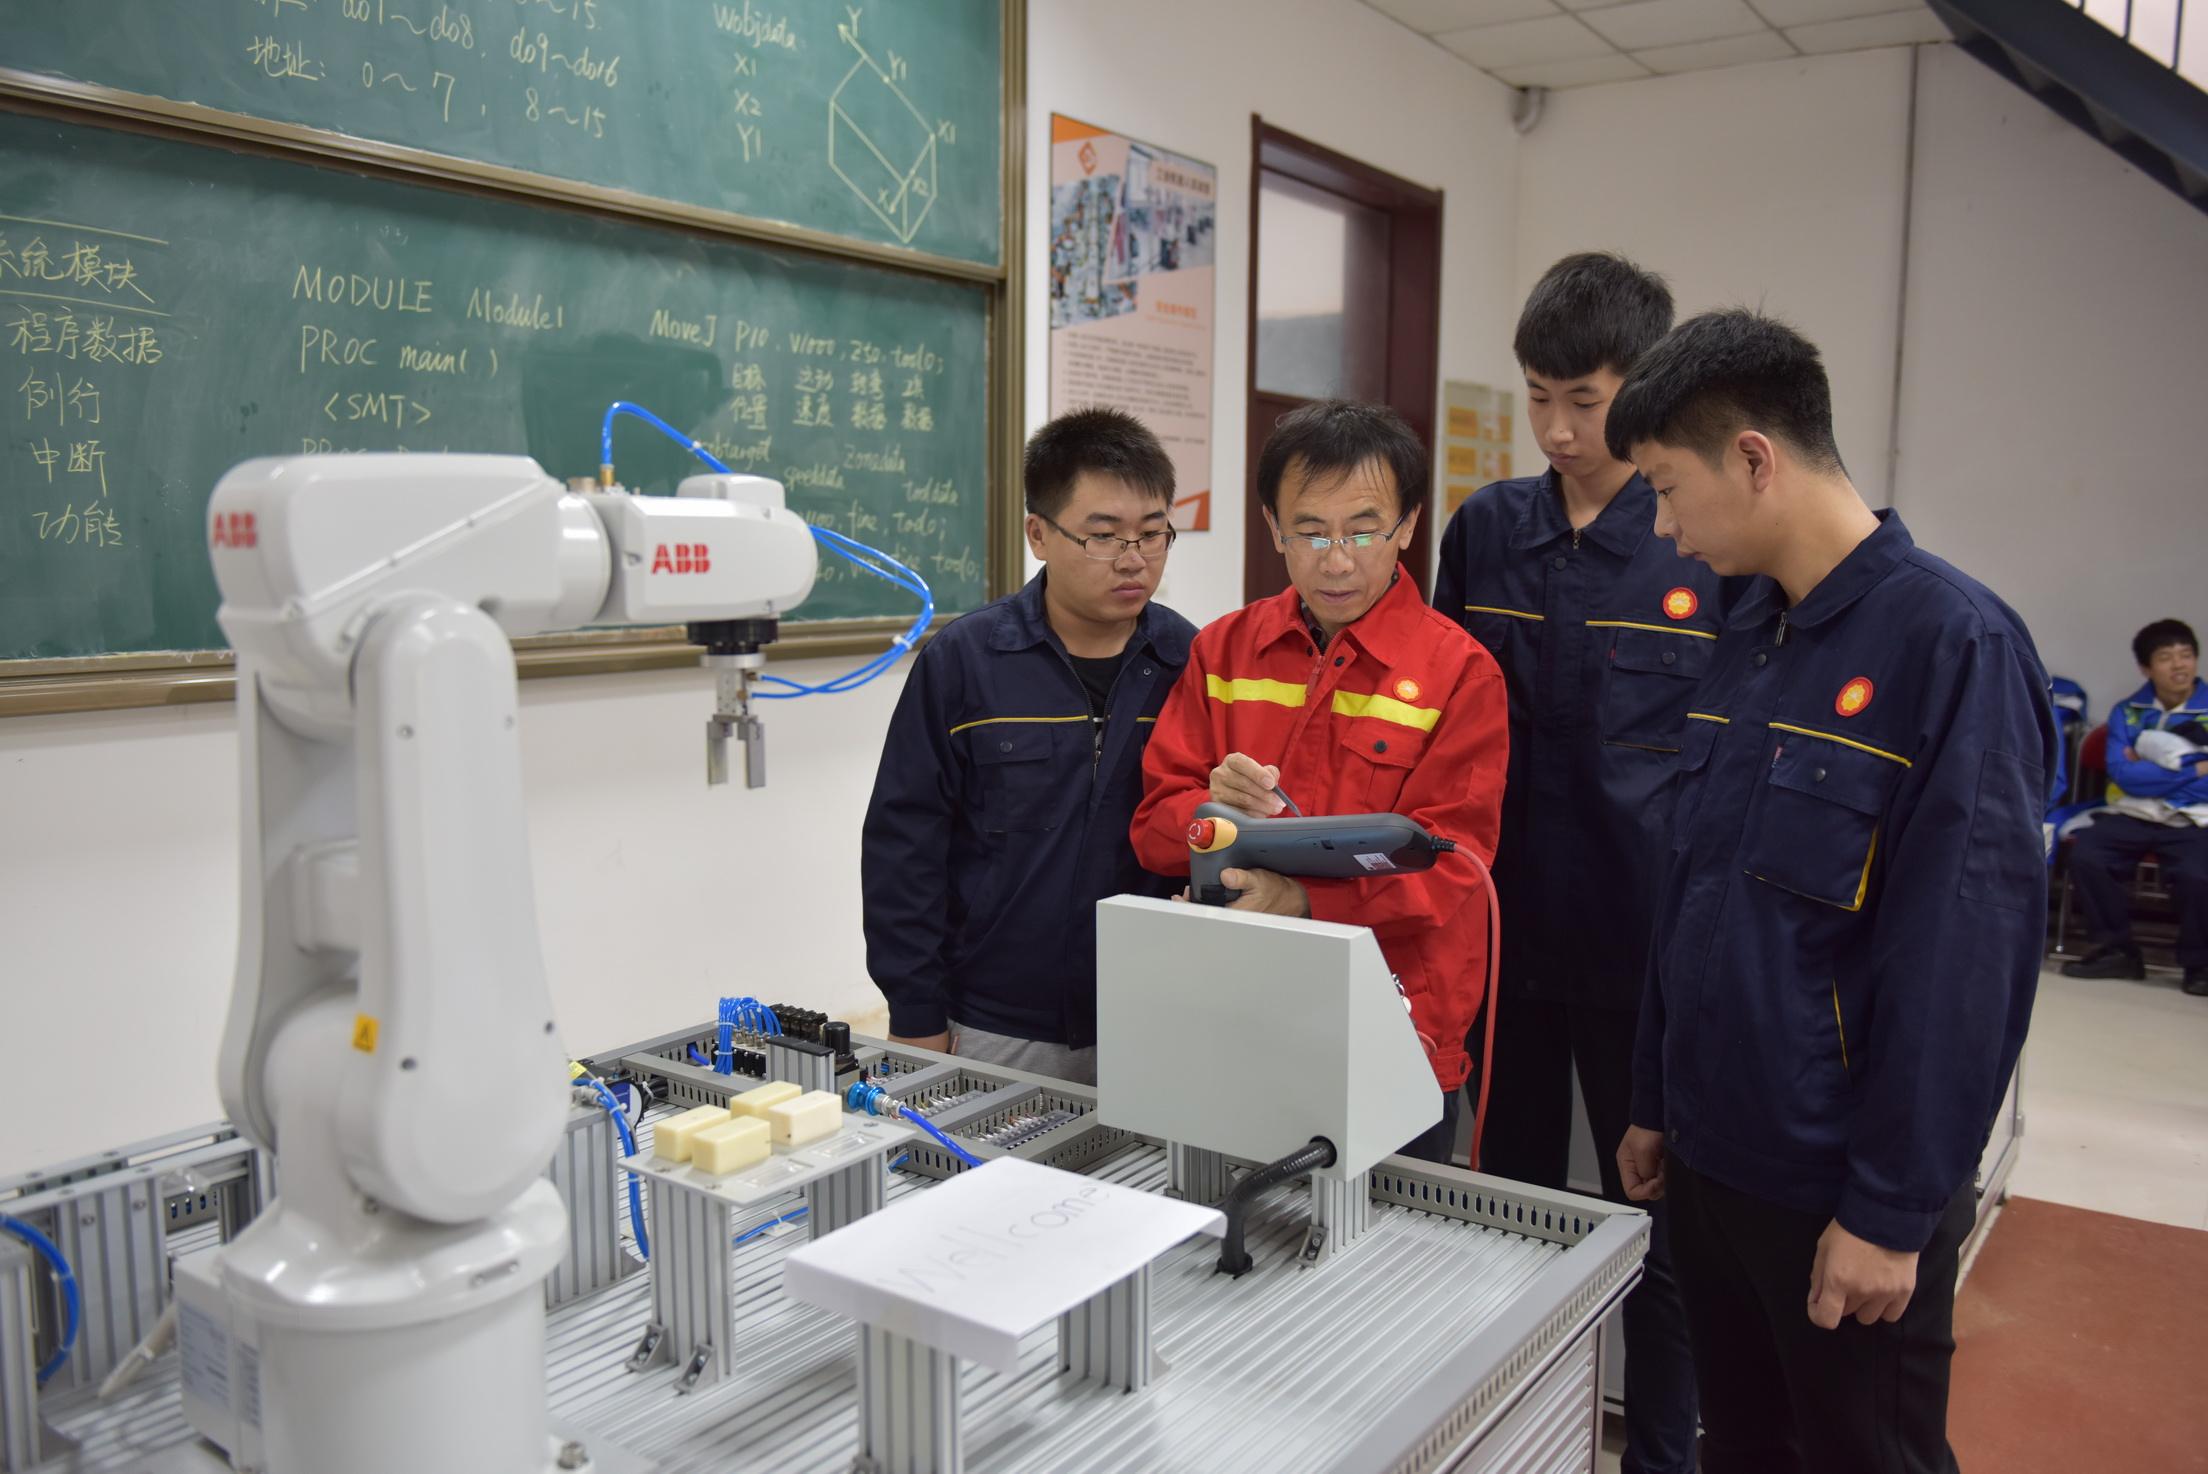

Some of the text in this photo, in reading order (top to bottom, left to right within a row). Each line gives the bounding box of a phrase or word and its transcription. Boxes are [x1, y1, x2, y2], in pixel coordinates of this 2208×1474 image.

[734, 52, 756, 76] X1
[293, 265, 432, 312] MODULE
[6, 304, 162, 364] 程序数据
[301, 325, 378, 373] PROC
[649, 309, 717, 347] MoveJ
[30, 438, 107, 496] 中断
[33, 500, 123, 547] 功能
[212, 512, 258, 548] ABB
[652, 544, 712, 575] ABB
